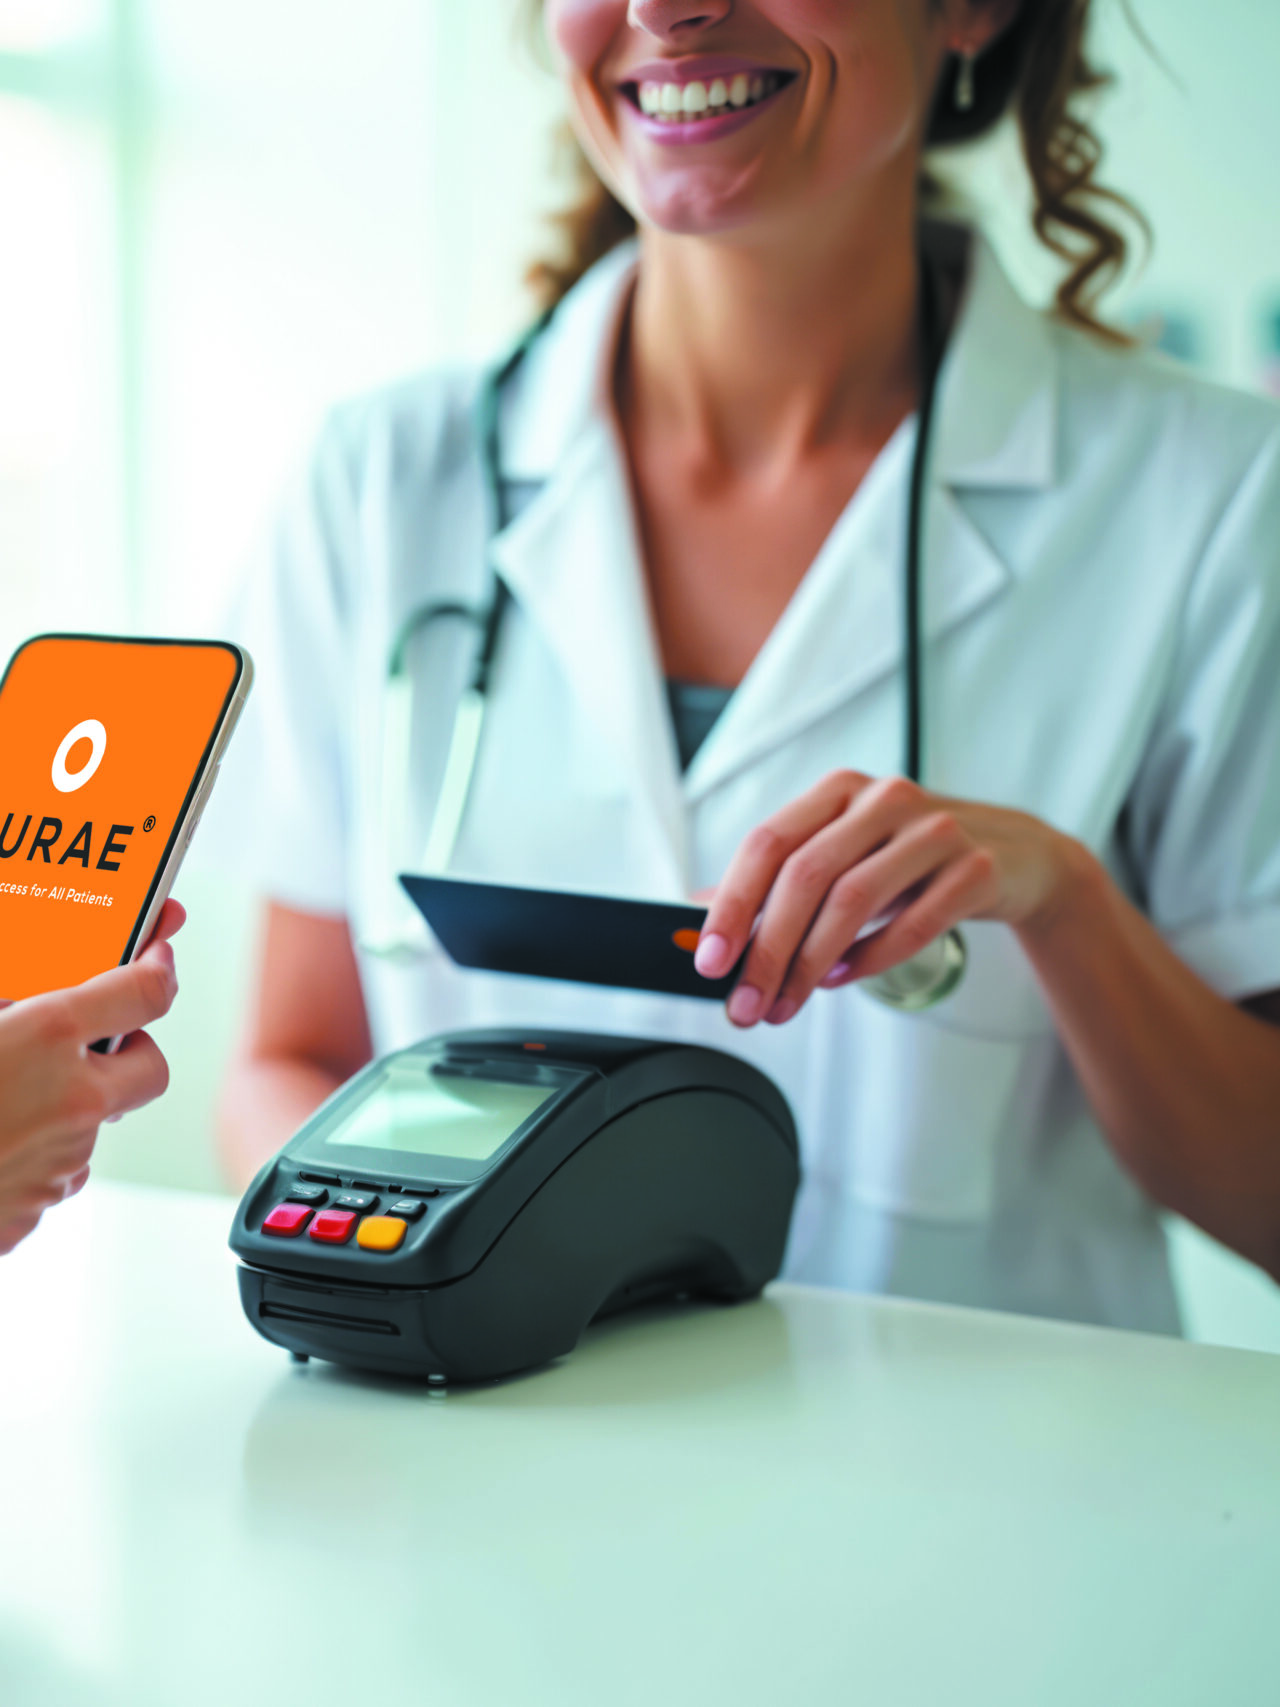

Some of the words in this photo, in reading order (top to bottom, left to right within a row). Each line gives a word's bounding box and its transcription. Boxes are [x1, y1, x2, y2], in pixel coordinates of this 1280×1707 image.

[29, 883, 47, 897] for
[48, 886, 66, 900] All
[66, 888, 113, 907] Patients
